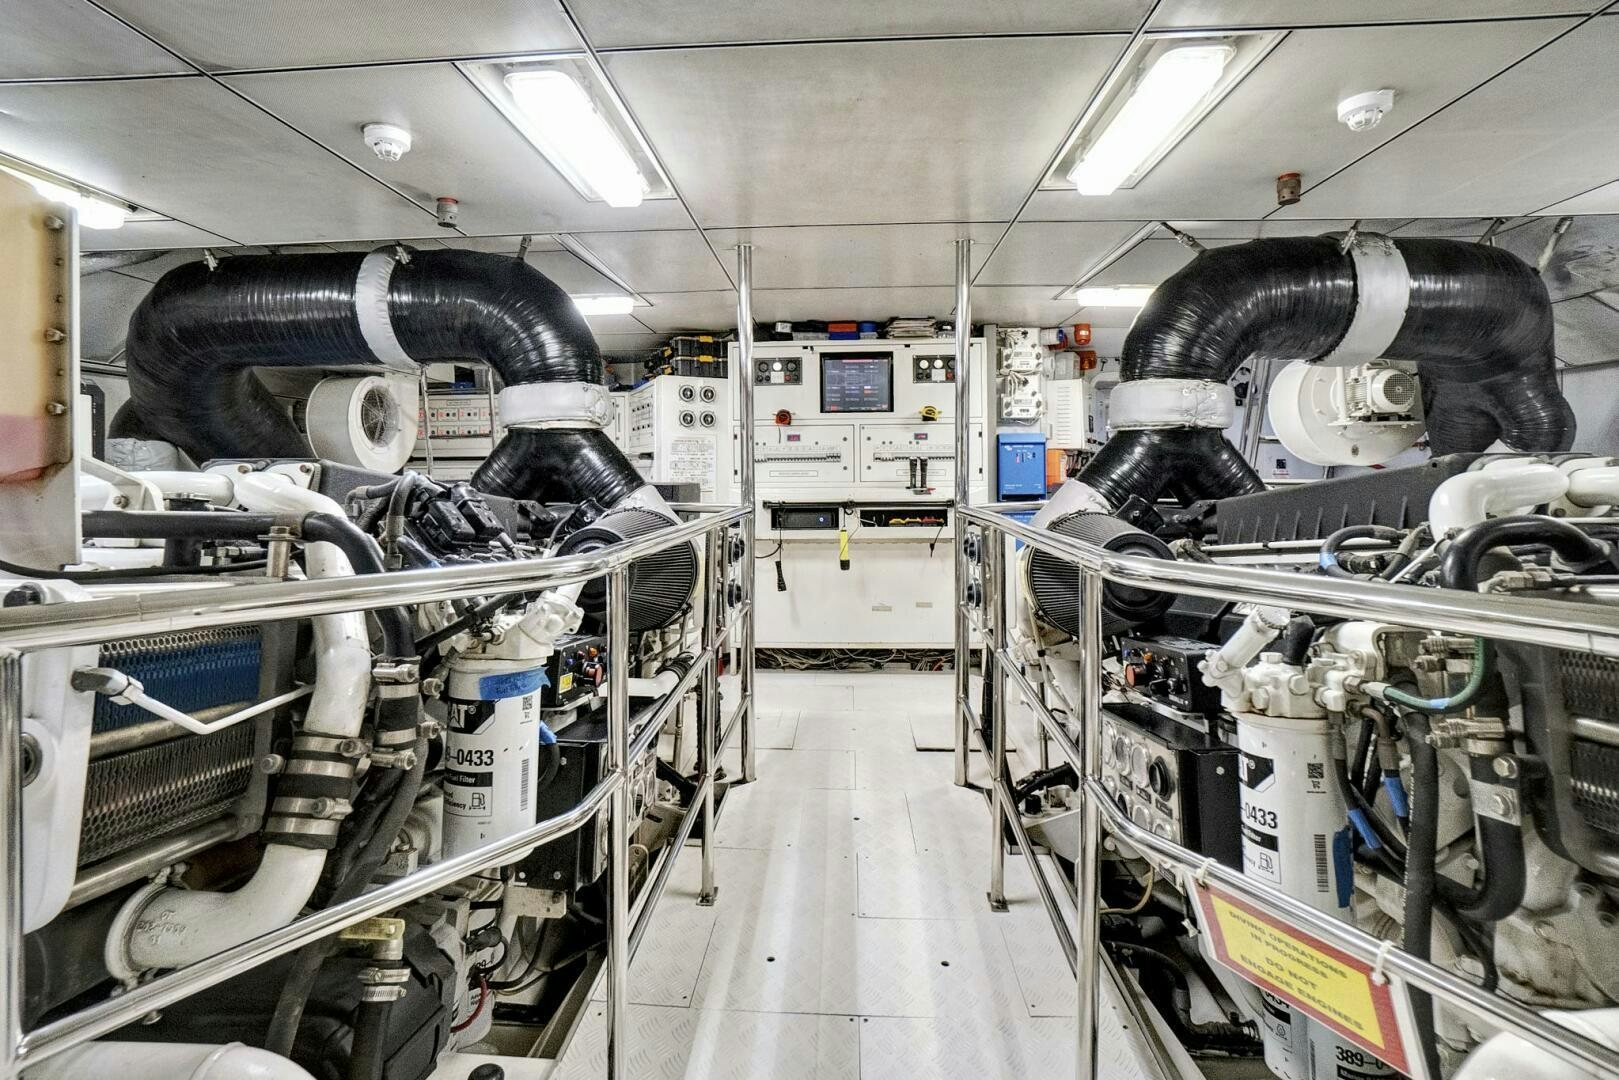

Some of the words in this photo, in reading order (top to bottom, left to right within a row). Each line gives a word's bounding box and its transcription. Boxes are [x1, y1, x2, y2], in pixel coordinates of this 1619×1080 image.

[1229, 911, 1266, 935] DIVING
[1269, 933, 1348, 979] OPERATIONS
[1250, 932, 1262, 943] IN
[1265, 940, 1329, 979] PROGRESS
[1265, 957, 1285, 972] DO
[1288, 969, 1318, 990] NOT
[1240, 954, 1294, 990] ENGAGE
[1297, 987, 1364, 1031] ENGINES
